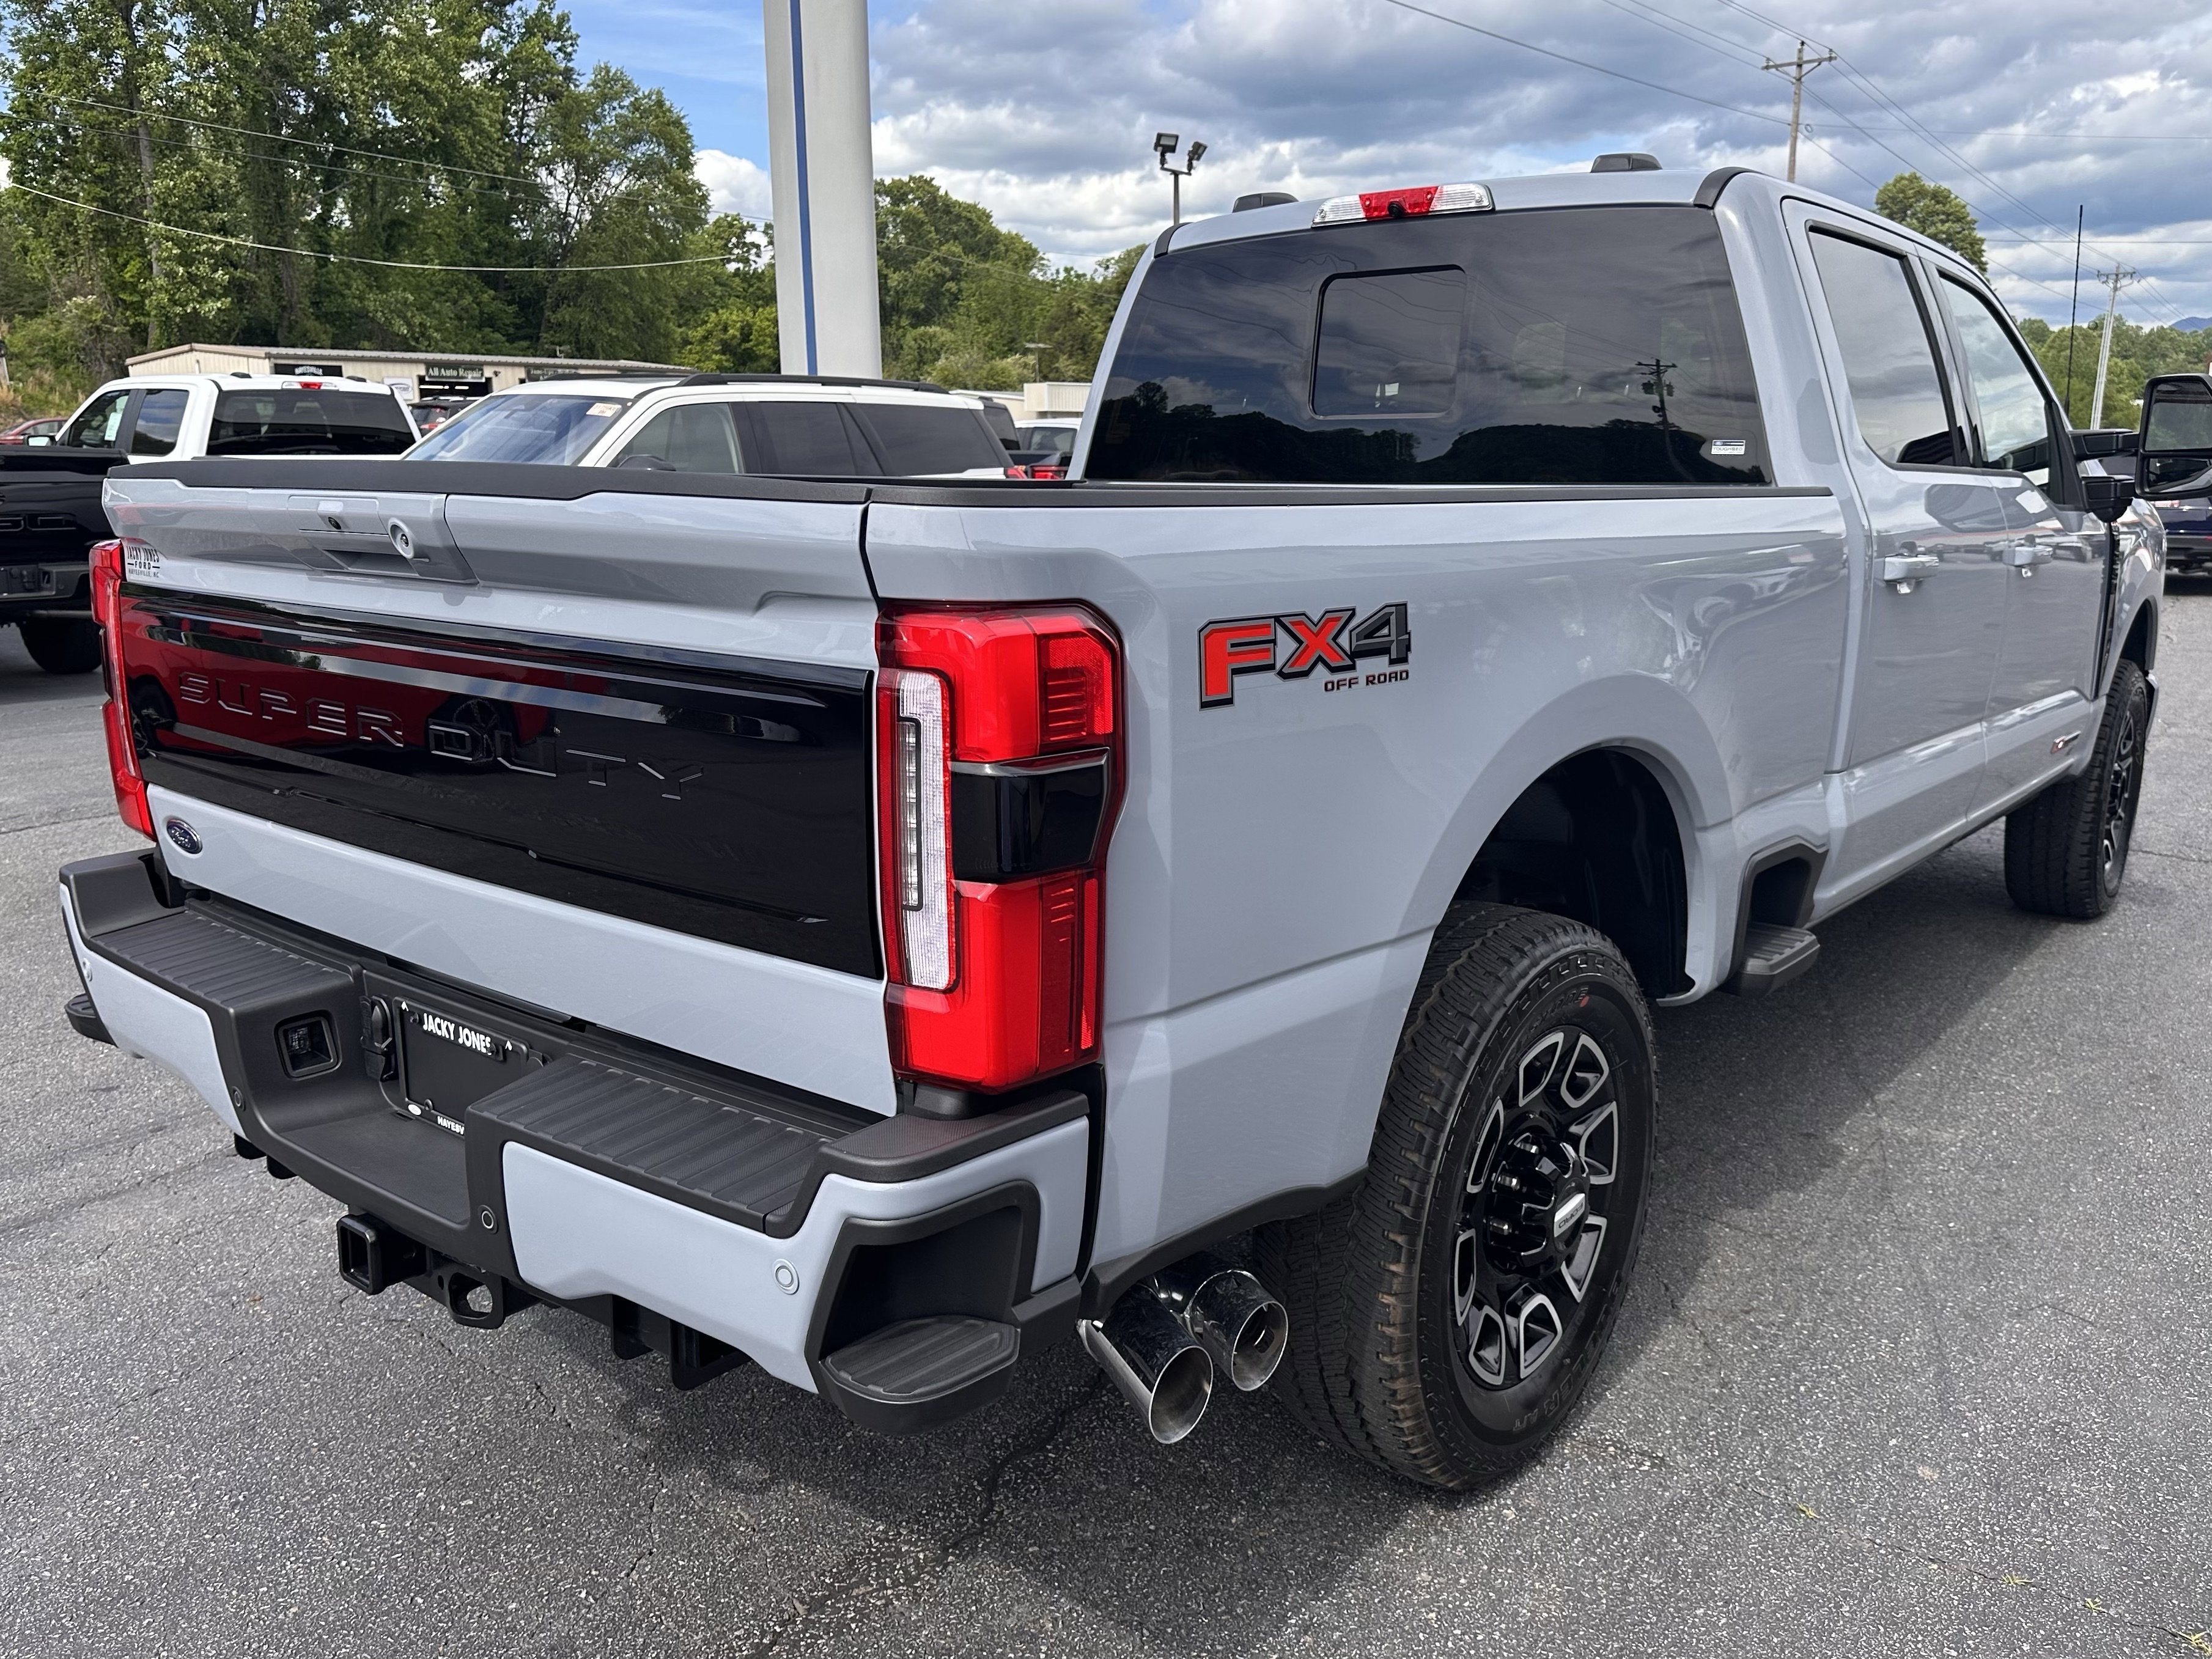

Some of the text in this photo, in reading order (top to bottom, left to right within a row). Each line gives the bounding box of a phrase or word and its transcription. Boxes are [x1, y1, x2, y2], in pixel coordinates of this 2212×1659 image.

[428, 367, 482, 379] All Auto Repair
[127, 546, 159, 562] JACKY JONES
[135, 561, 151, 570] FORD
[1196, 601, 1412, 712] FX4
[1324, 669, 1409, 693] OFF ROAD
[179, 672, 704, 800] SUPER DUTY
[422, 1013, 492, 1056] JACKY JONES
[437, 1116, 465, 1135] HAYESV
[1558, 1202, 1584, 1228] FORD
